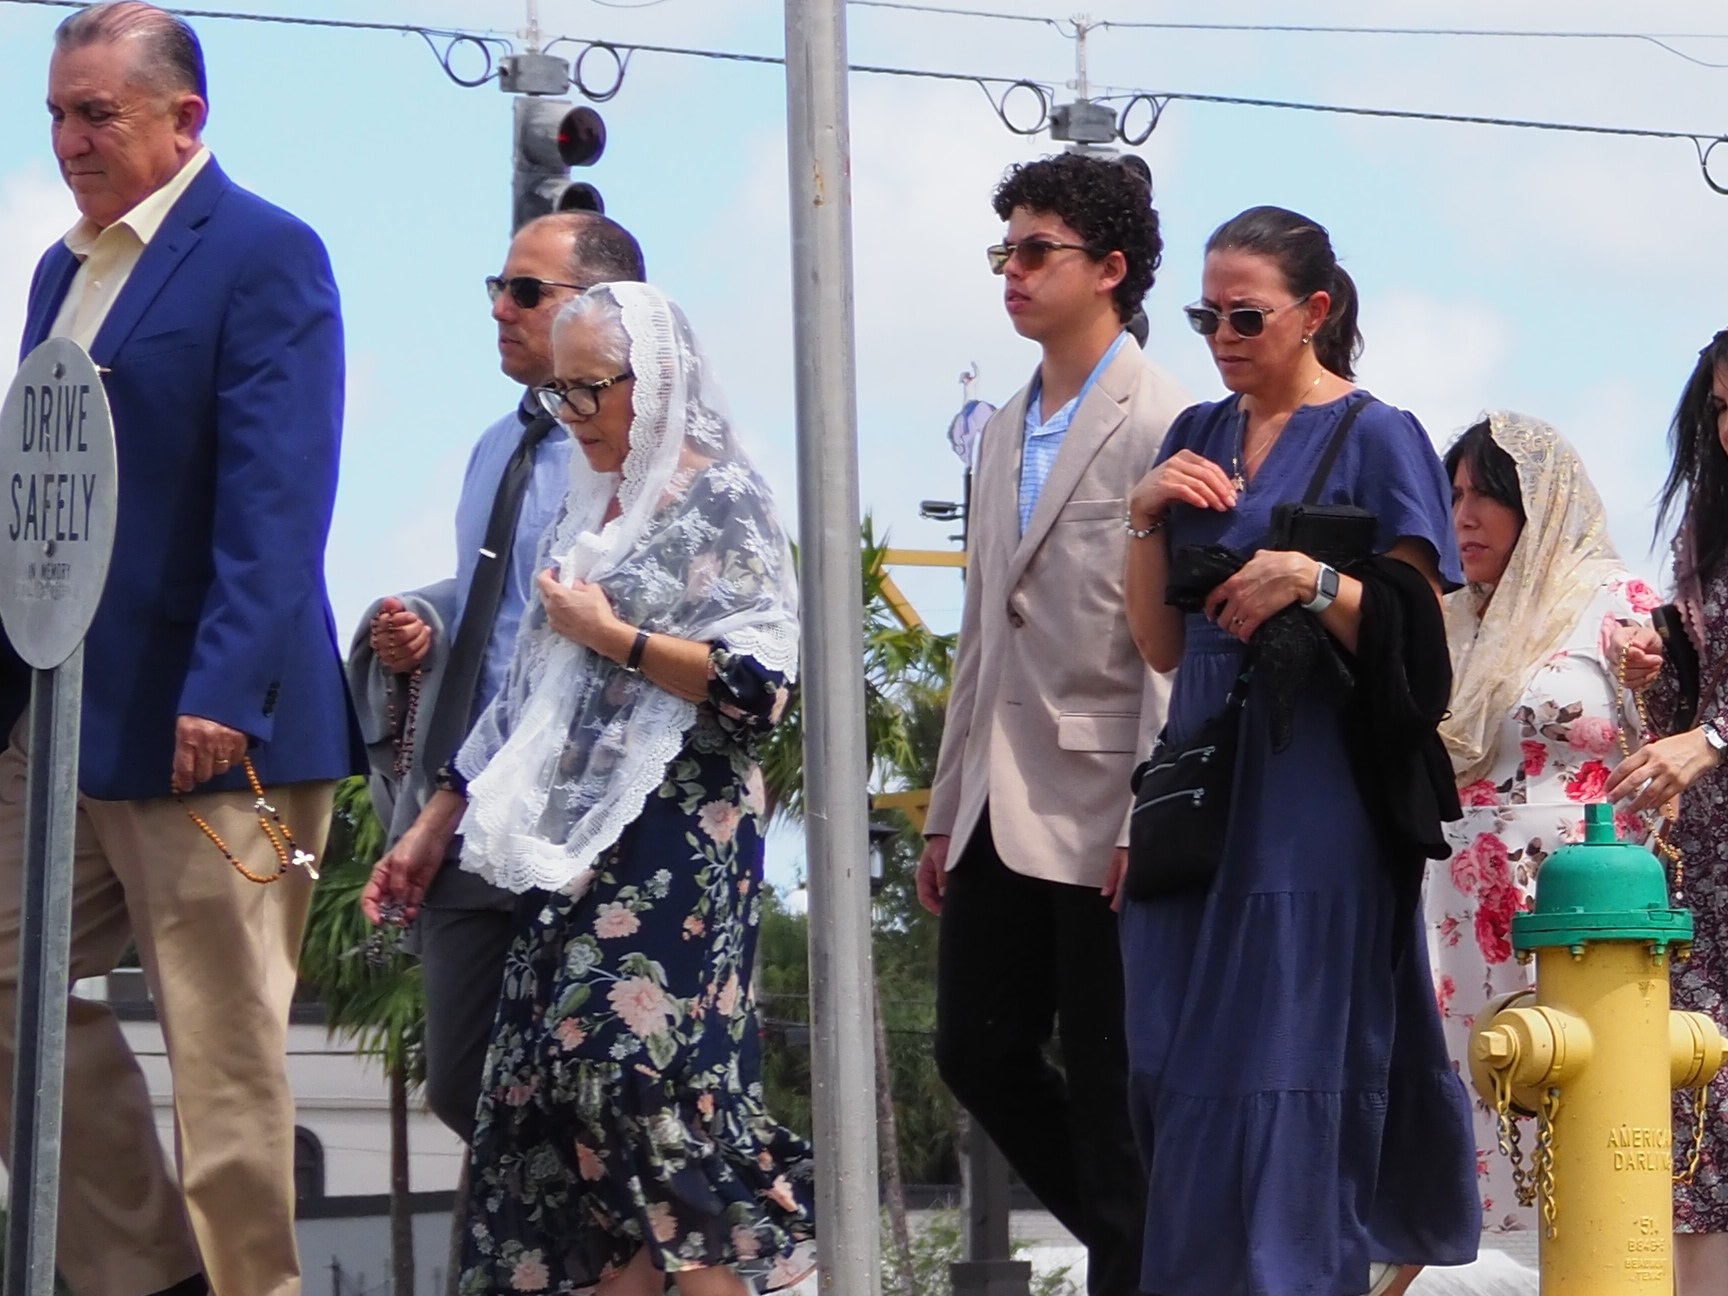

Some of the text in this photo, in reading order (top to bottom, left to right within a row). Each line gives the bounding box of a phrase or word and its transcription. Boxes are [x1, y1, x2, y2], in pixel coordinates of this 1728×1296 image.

[22, 385, 90, 452] DRIVE
[9, 472, 97, 542] SAFELY
[1606, 1127, 1671, 1148] AMERICA
[1613, 1150, 1671, 1171] DARLIN
